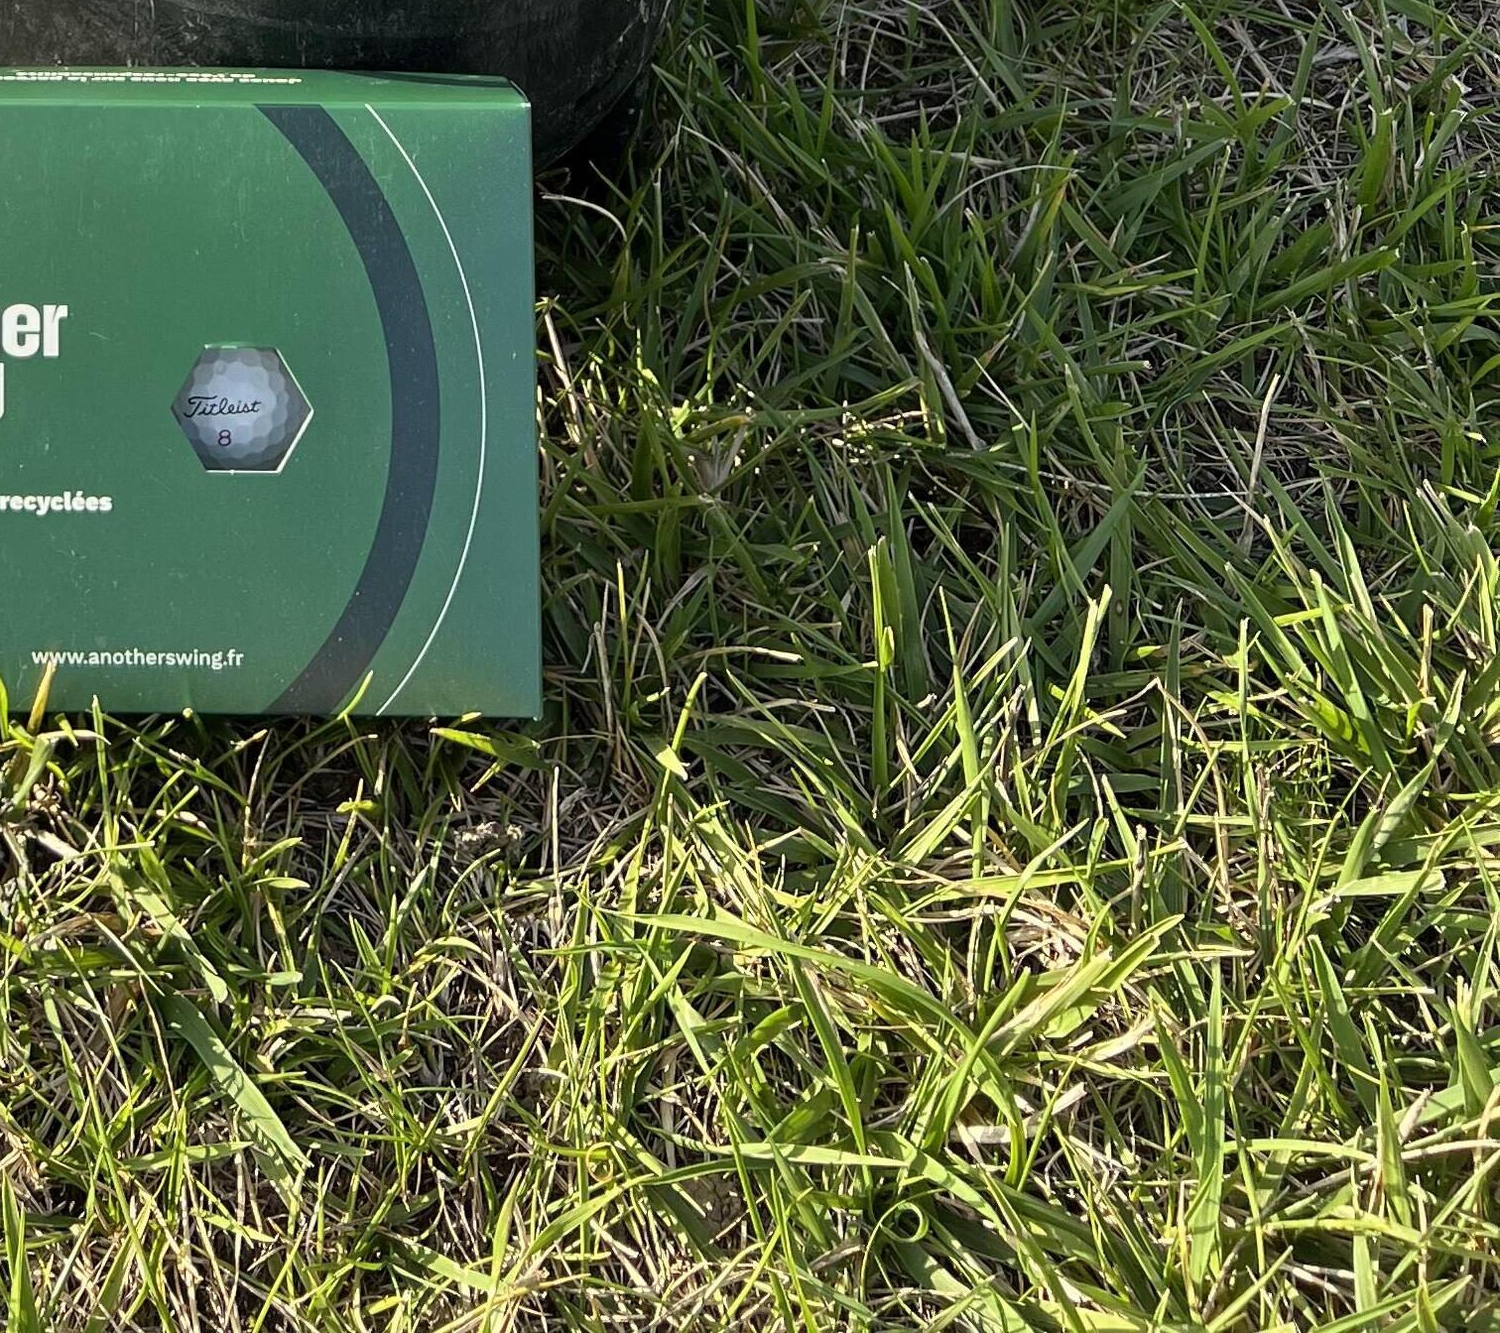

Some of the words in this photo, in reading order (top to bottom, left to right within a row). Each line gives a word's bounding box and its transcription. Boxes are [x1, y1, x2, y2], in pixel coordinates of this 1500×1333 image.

[183, 395, 262, 418] Titleist
[218, 429, 232, 447] 8
[31, 648, 245, 671] www.anotherswing.fr
